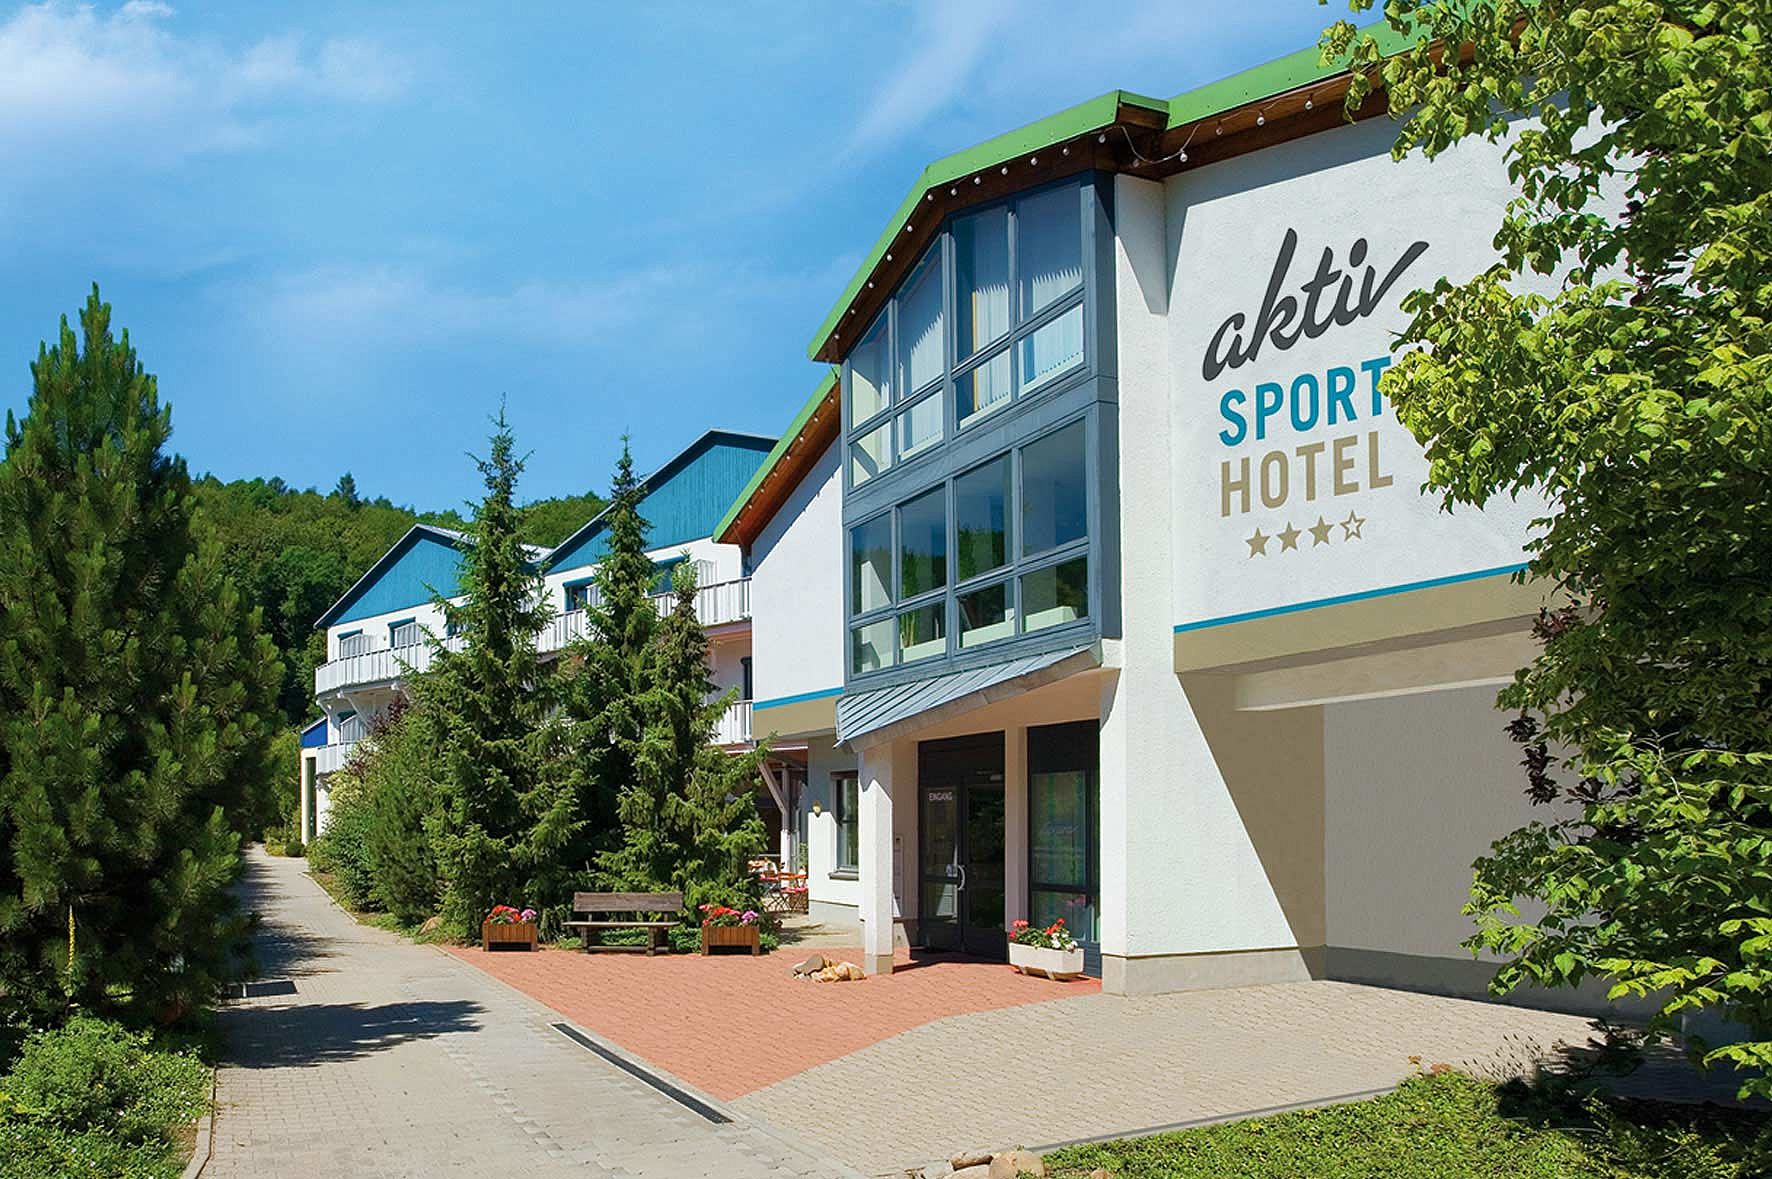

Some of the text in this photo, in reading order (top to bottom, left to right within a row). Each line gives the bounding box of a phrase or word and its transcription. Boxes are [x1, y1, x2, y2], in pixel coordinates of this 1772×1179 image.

[1202, 227, 1430, 382] aktiv
[1218, 355, 1392, 447] SPORT
[1220, 430, 1394, 518] HOTEL
